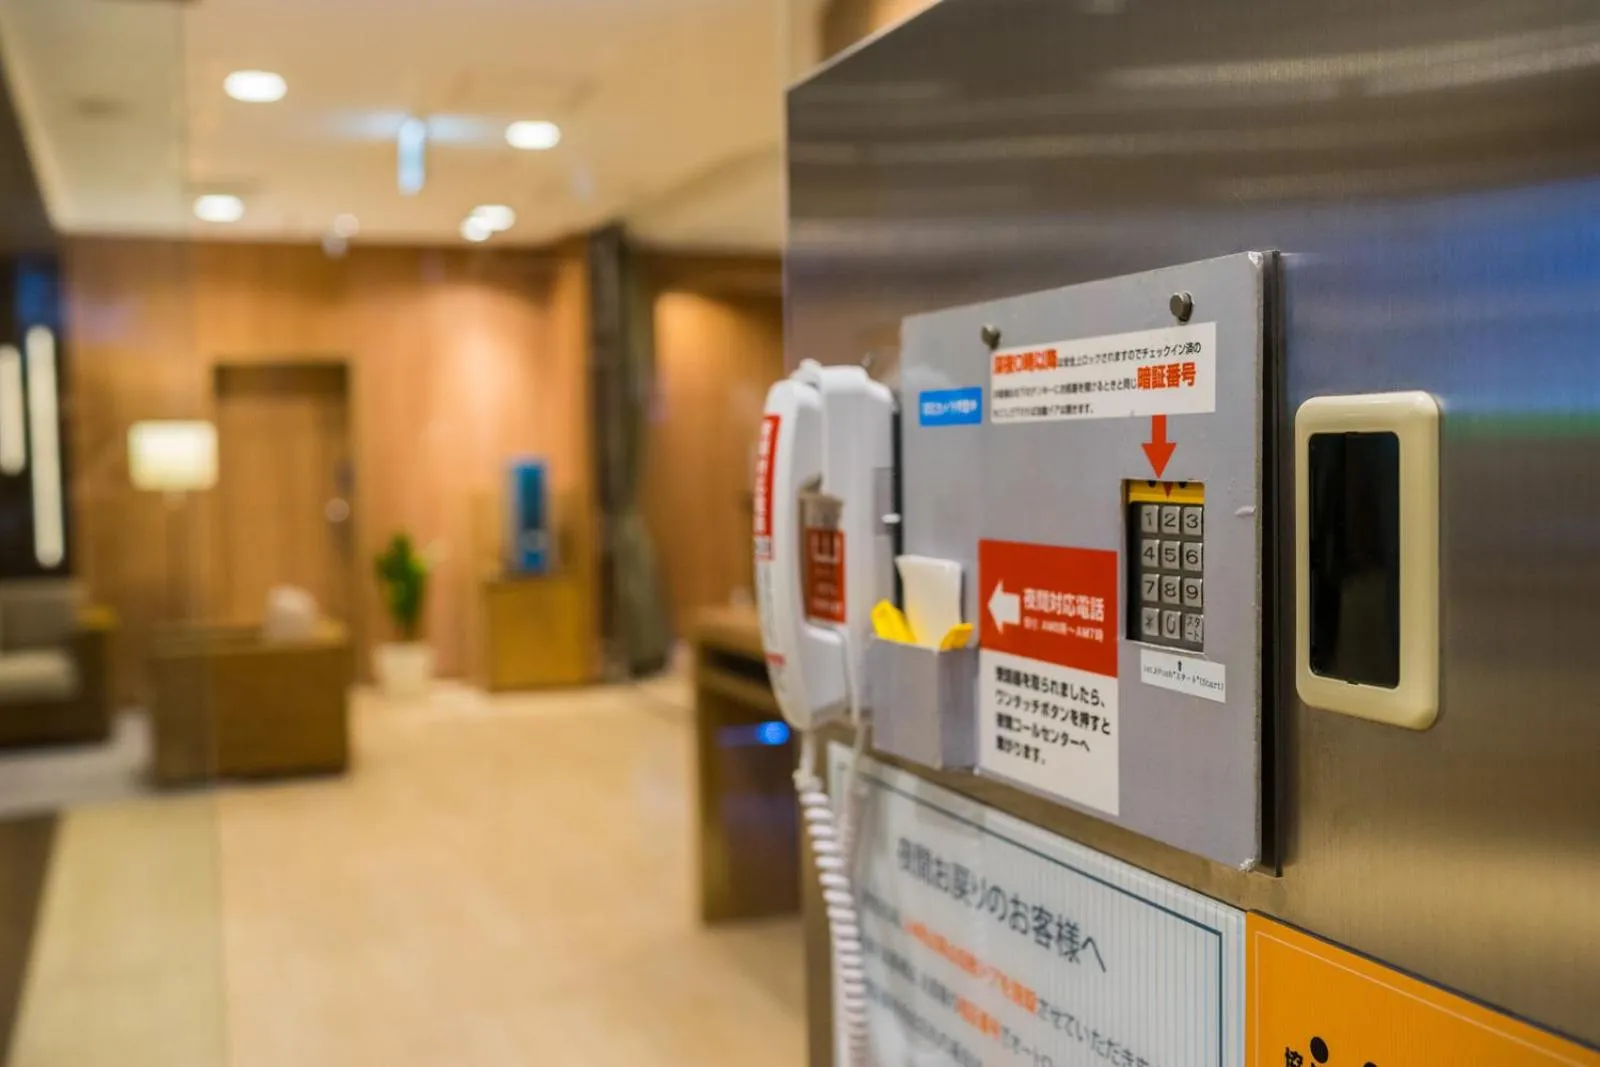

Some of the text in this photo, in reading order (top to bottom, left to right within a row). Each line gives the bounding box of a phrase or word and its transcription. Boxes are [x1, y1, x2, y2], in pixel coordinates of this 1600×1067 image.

[1144, 513, 1199, 529] 1 2 3
[1143, 546, 1199, 565] 4 5 6
[1144, 580, 1199, 600] 7 8 9
[1166, 614, 1175, 635] 0
[996, 689, 1111, 735] ワンタッチボタンを押すと
[897, 837, 1107, 974] 夜間お戻りのお客様へ
